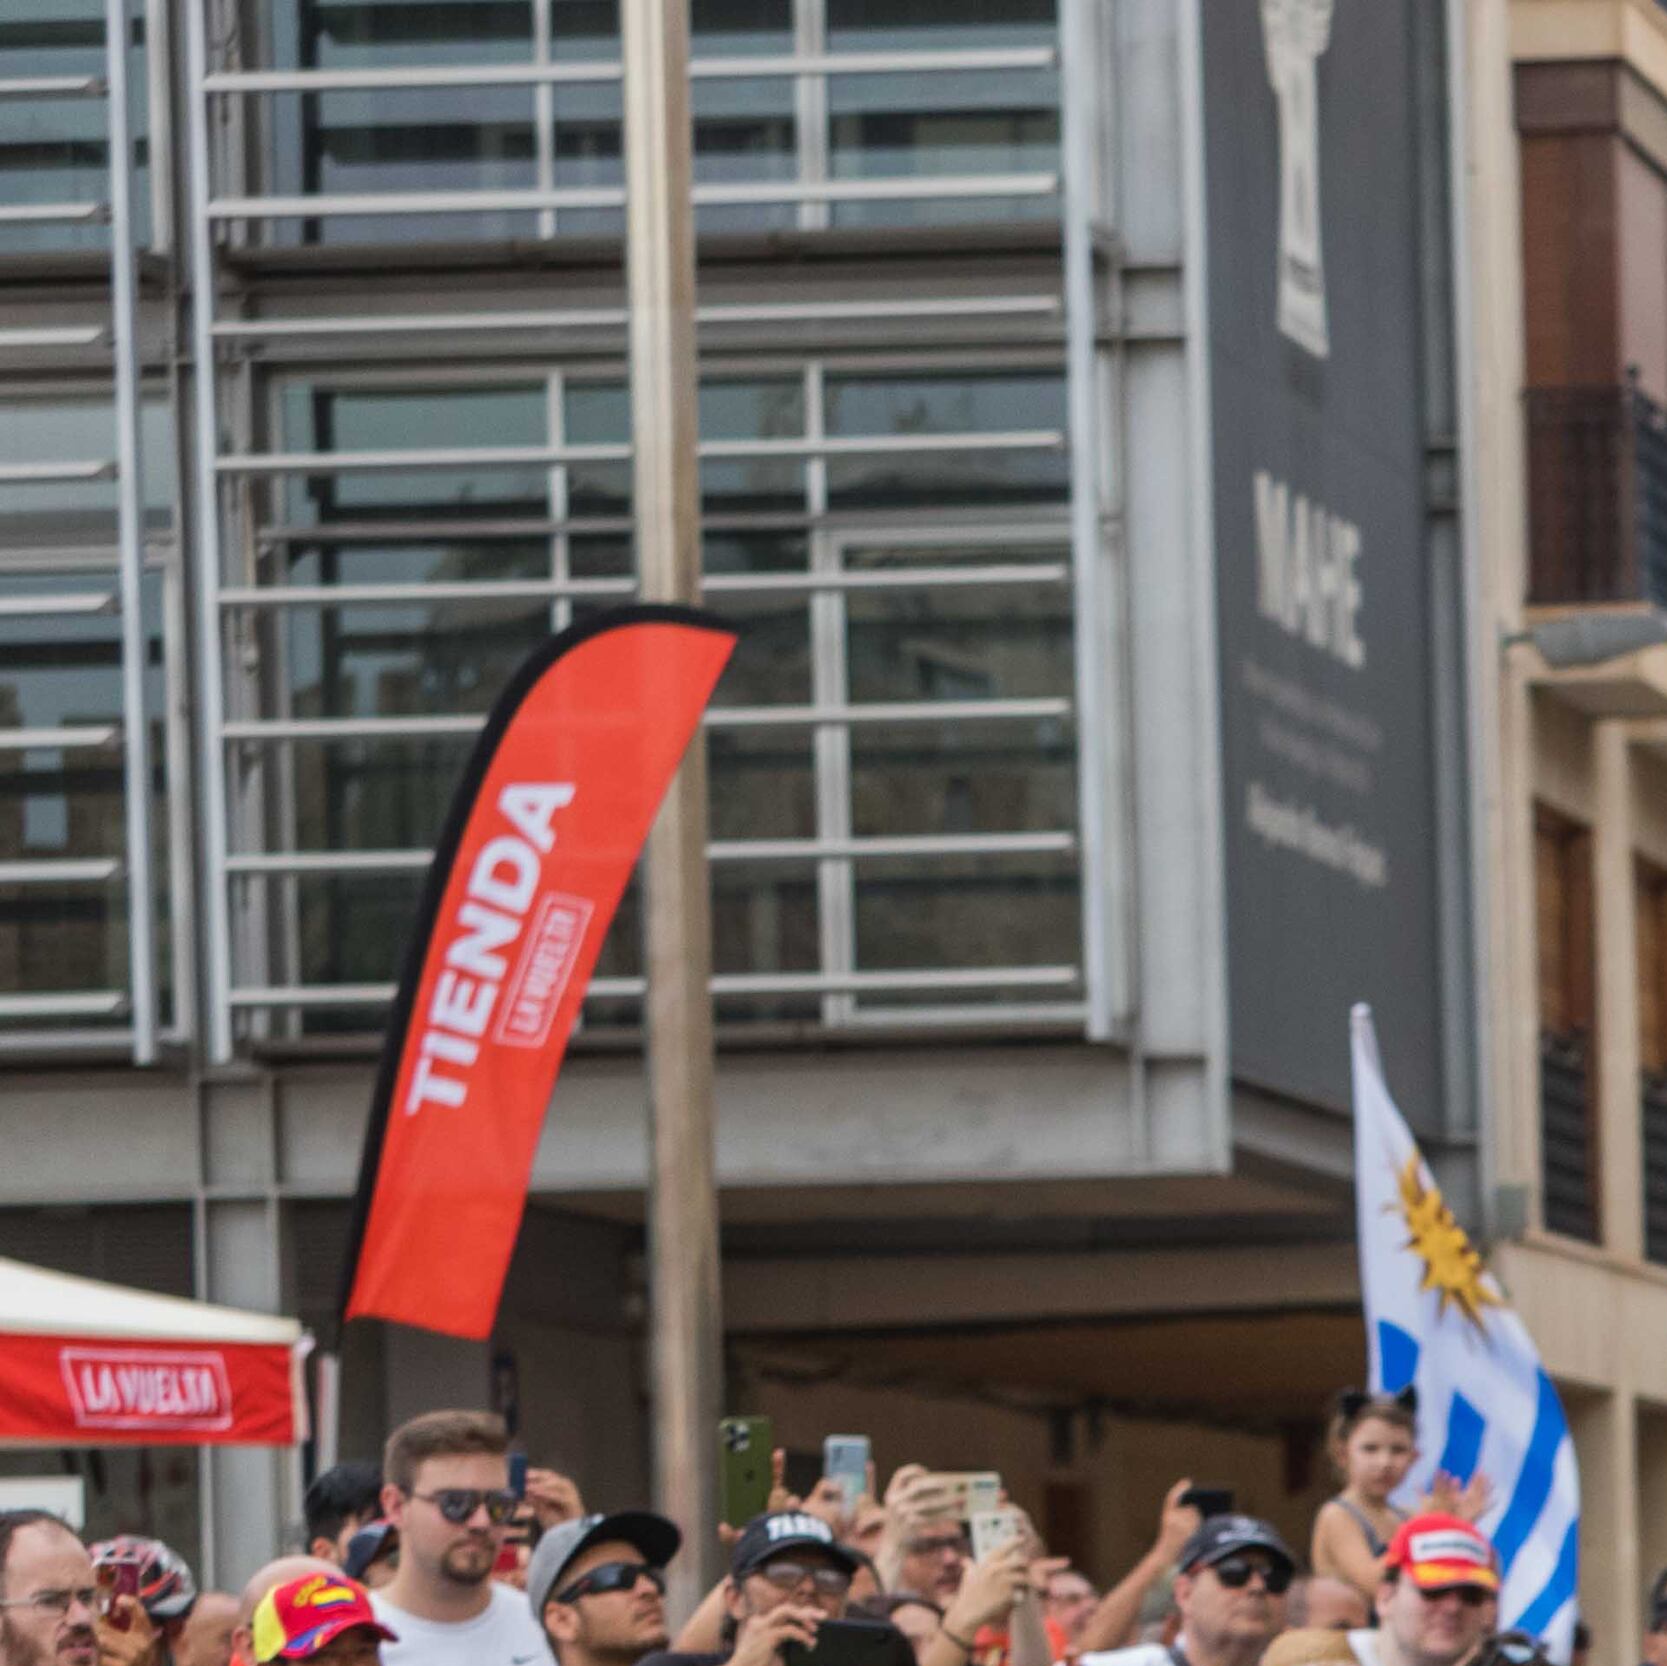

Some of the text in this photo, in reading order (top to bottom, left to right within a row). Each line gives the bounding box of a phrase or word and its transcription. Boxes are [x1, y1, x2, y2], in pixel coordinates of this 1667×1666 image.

[404, 782, 577, 1116] TIENDA
[80, 1363, 218, 1414] LA VUELTA
